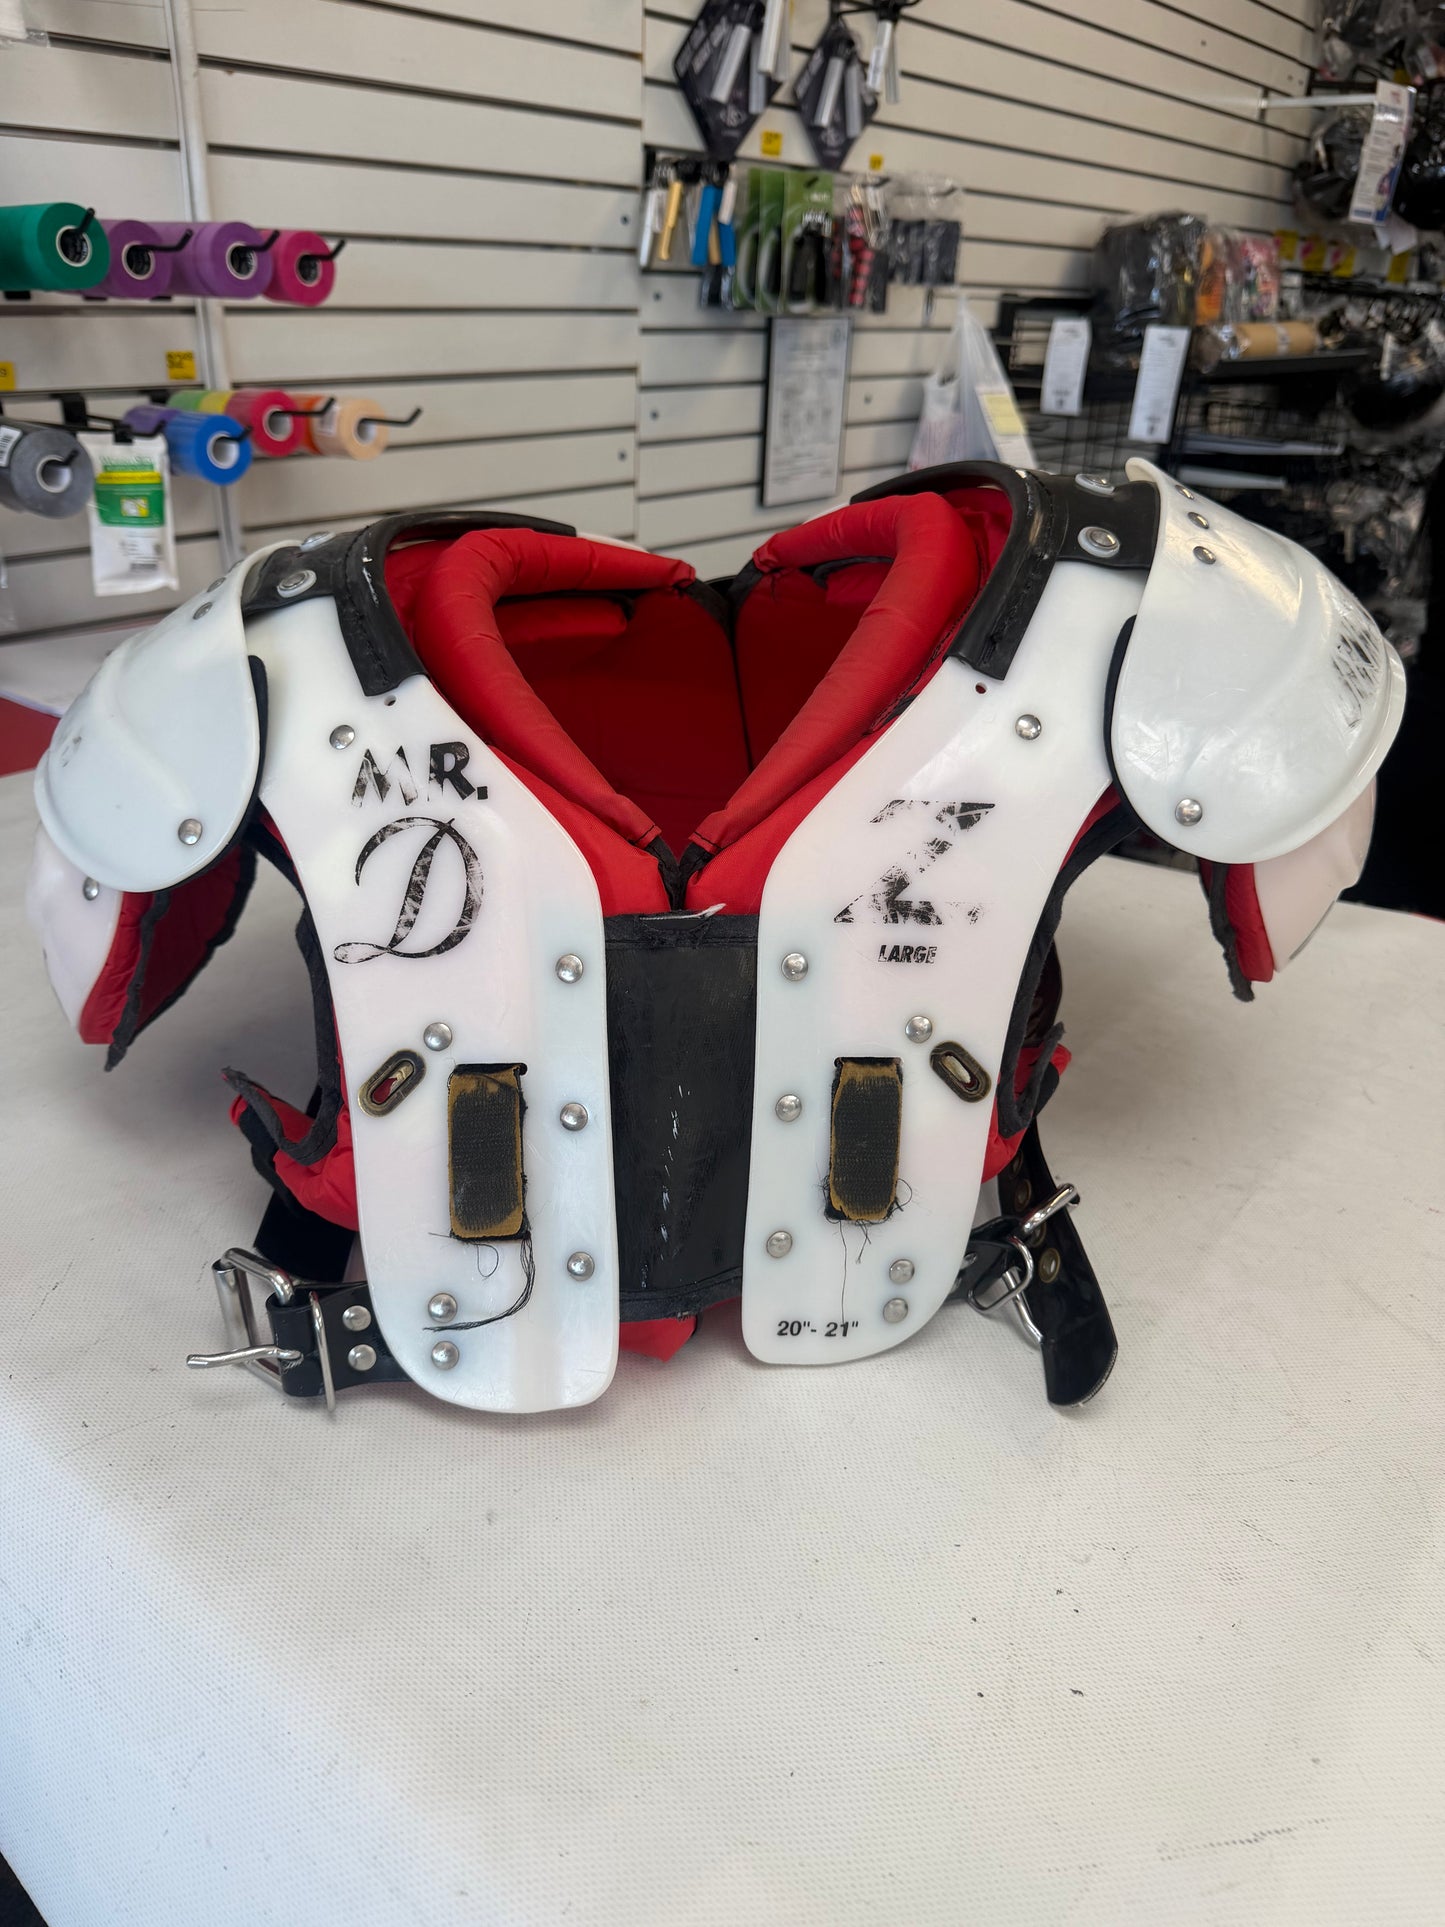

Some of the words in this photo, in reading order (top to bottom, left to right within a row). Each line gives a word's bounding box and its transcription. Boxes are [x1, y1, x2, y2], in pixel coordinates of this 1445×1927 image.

[351, 741, 488, 808] MR.
[334, 816, 484, 964] D
[878, 944, 937, 964] LARGE
